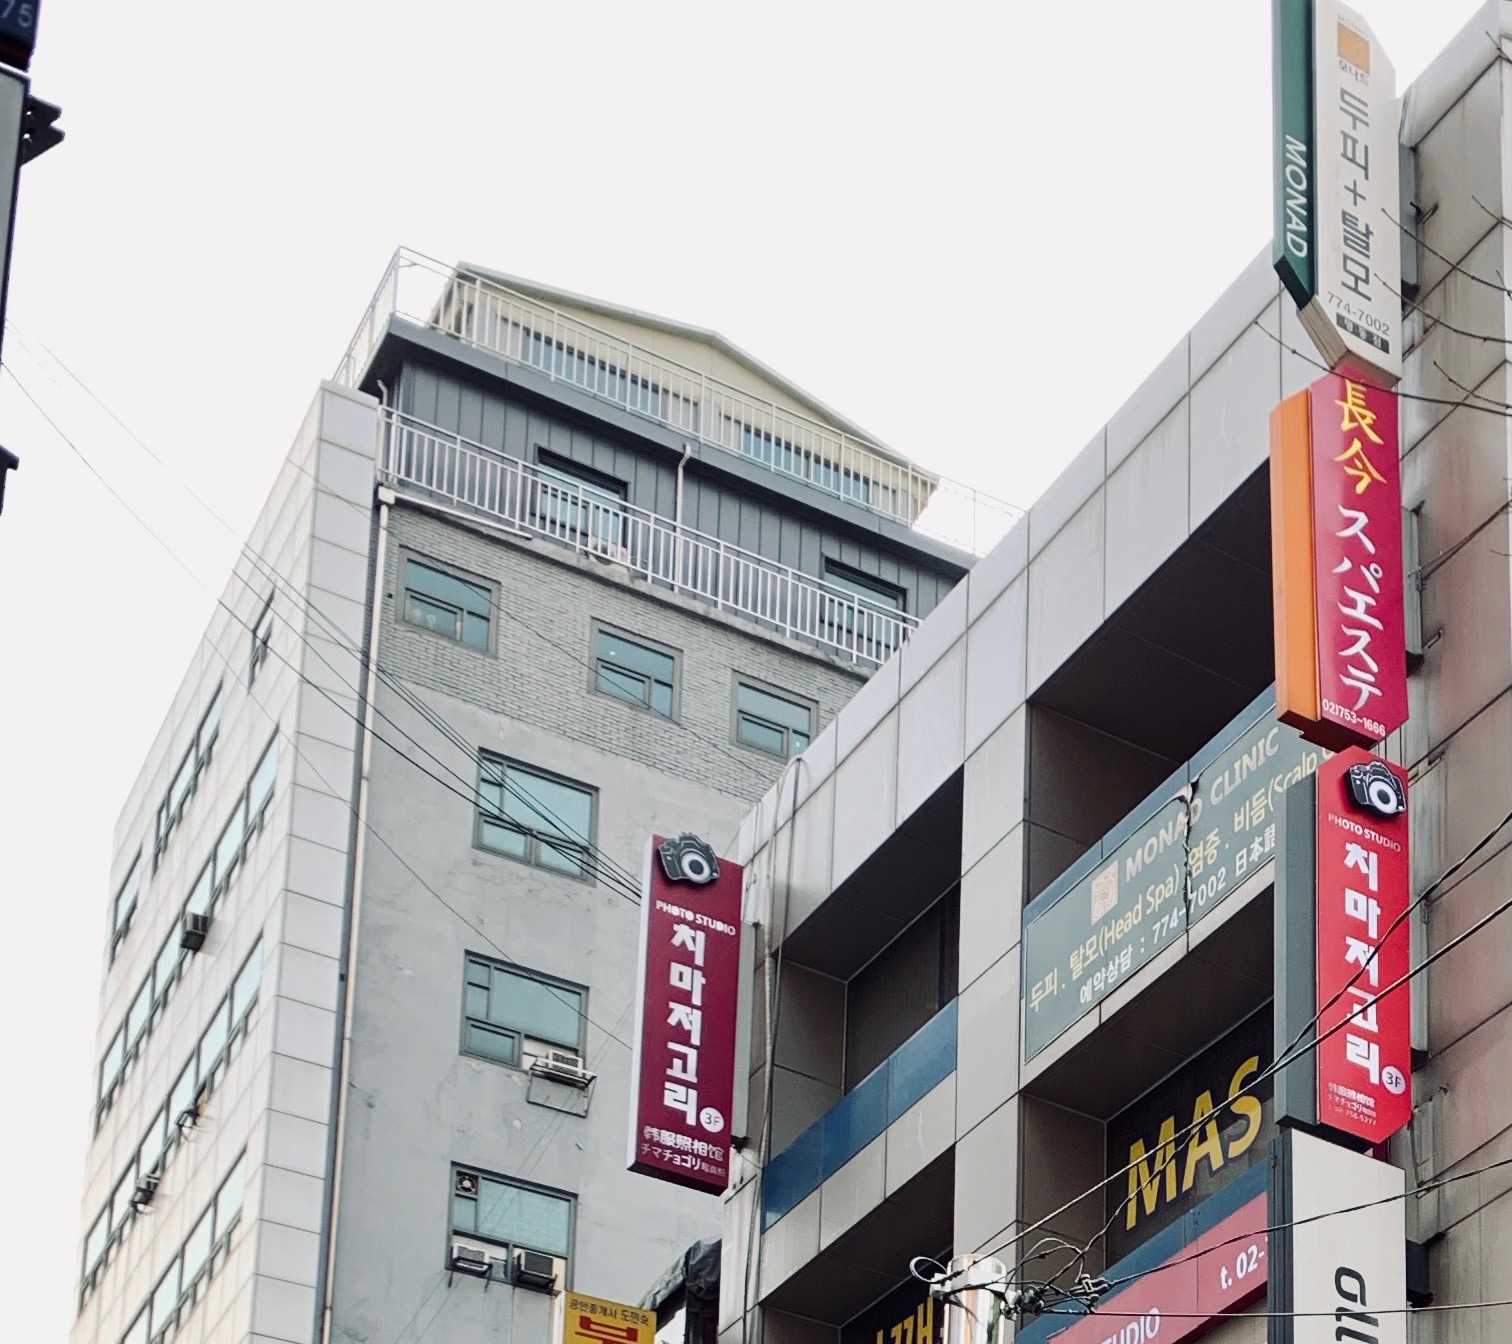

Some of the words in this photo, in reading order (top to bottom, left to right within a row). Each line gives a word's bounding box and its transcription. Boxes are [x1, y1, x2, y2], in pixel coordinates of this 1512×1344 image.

[1285, 134, 1308, 258] MONAD
[1327, 291, 1390, 337] 774-7002
[1322, 699, 1387, 738] 02)753-1666
[1125, 798, 1203, 882] MONAD
[1210, 727, 1280, 805] CLINIC
[1328, 812, 1363, 837] PHOTO
[1363, 827, 1402, 853] STUDIO
[656, 900, 694, 923] PHOTO
[694, 911, 737, 937] STUDIO
[1146, 865, 1180, 926] Spa)
[1080, 947, 1134, 1004] 예약상담
[1152, 866, 1227, 945] 774-7002
[1343, 841, 1382, 1086] 치마저고리
[664, 922, 707, 1127] 치마저고리
[1386, 1071, 1402, 1088] 3F
[704, 1112, 721, 1126] 3F
[1125, 1055, 1264, 1231] MAS
